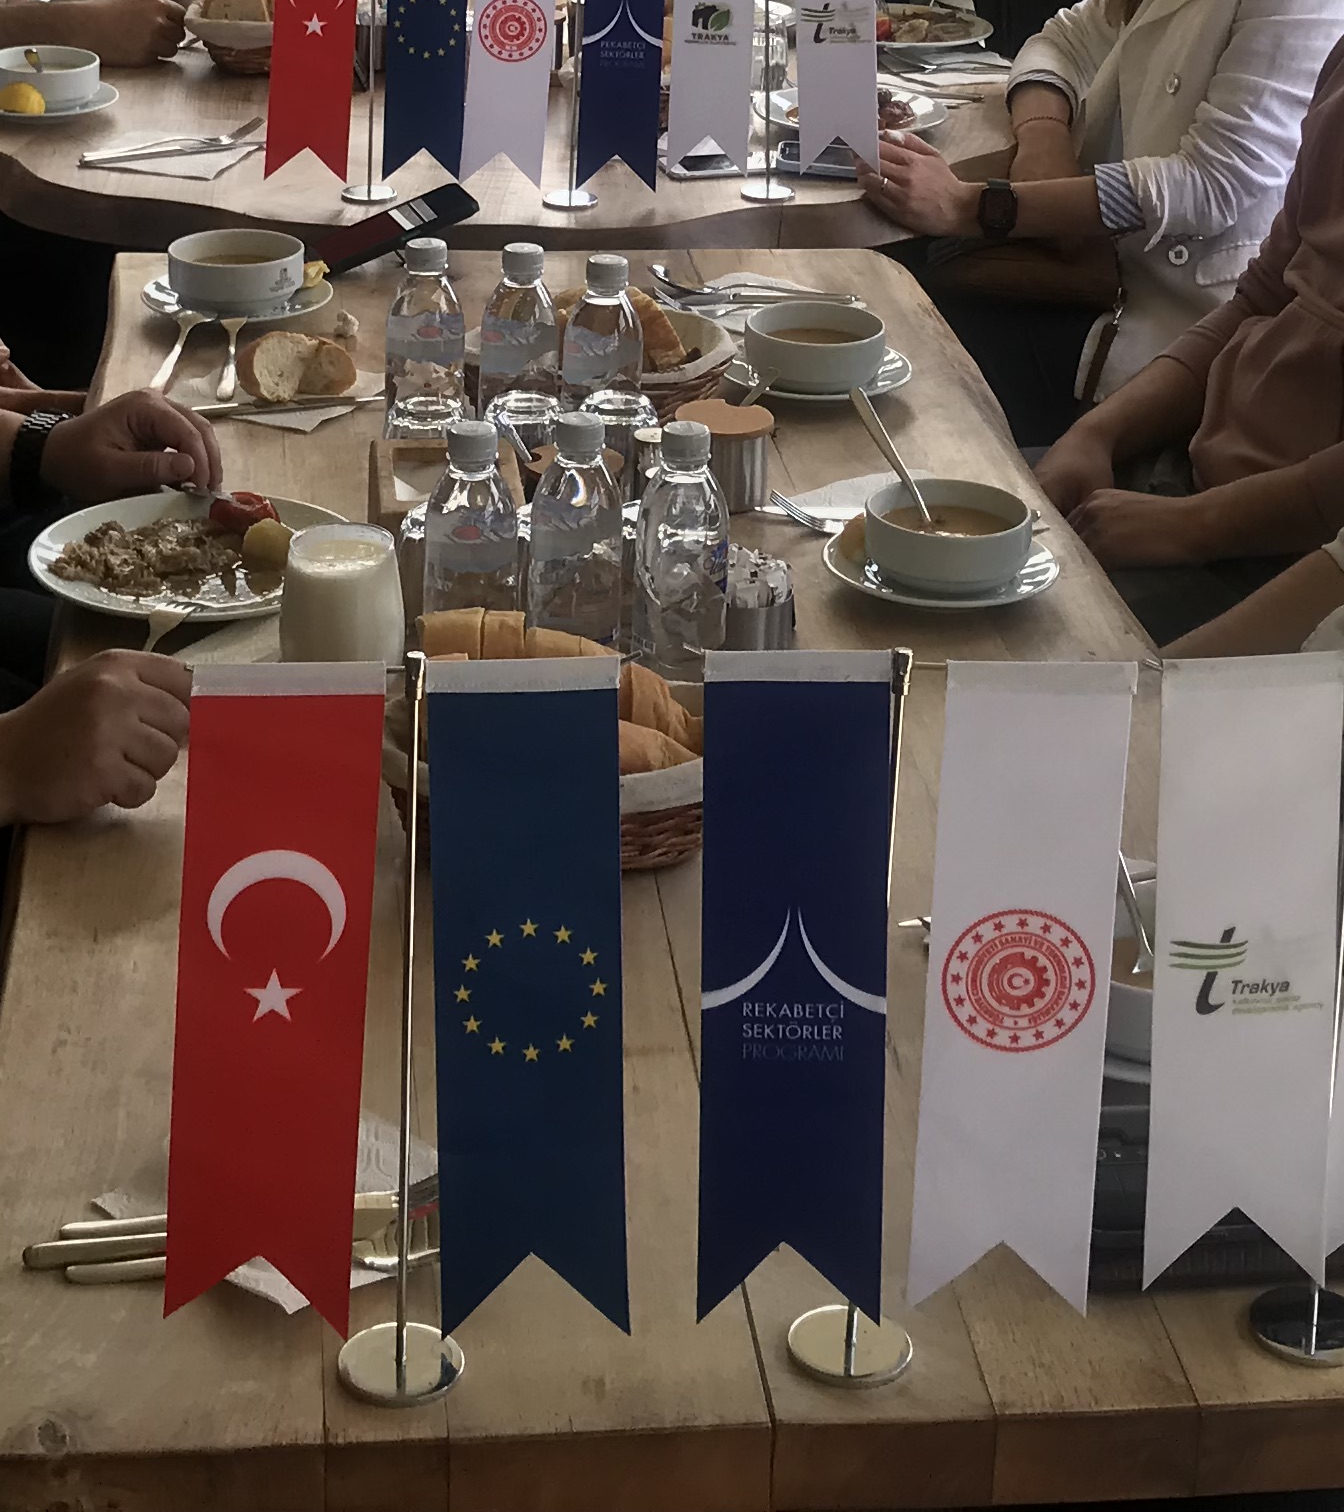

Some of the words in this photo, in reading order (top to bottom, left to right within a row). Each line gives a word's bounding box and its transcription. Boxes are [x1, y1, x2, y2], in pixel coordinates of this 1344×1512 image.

[1231, 979, 1290, 997] Trakya
[743, 1000, 844, 1023] REKABETÇİ
[742, 1020, 842, 1040] SEKTÖRLER
